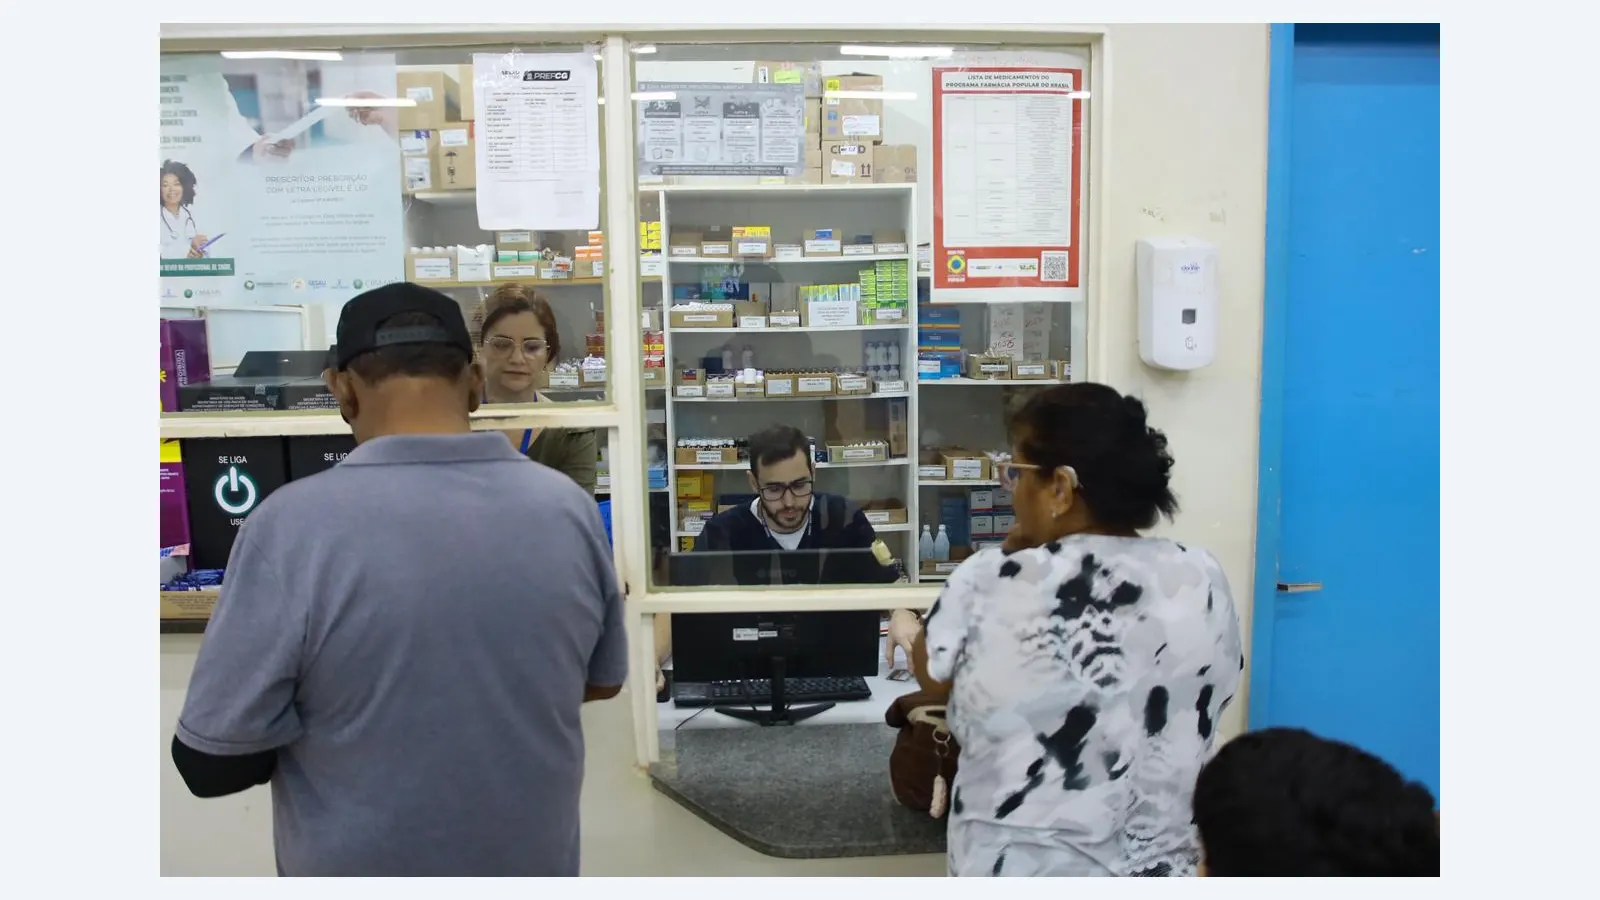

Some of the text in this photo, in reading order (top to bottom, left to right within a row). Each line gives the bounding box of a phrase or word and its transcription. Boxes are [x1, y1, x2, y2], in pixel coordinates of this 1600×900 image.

[533, 72, 569, 80] PREFCG
[265, 175, 315, 183] PRESCRITOR
[266, 186, 284, 194] COM
[285, 186, 311, 194] LETRA
[218, 455, 248, 464] SE LIGA
[323, 452, 334, 461] SE
